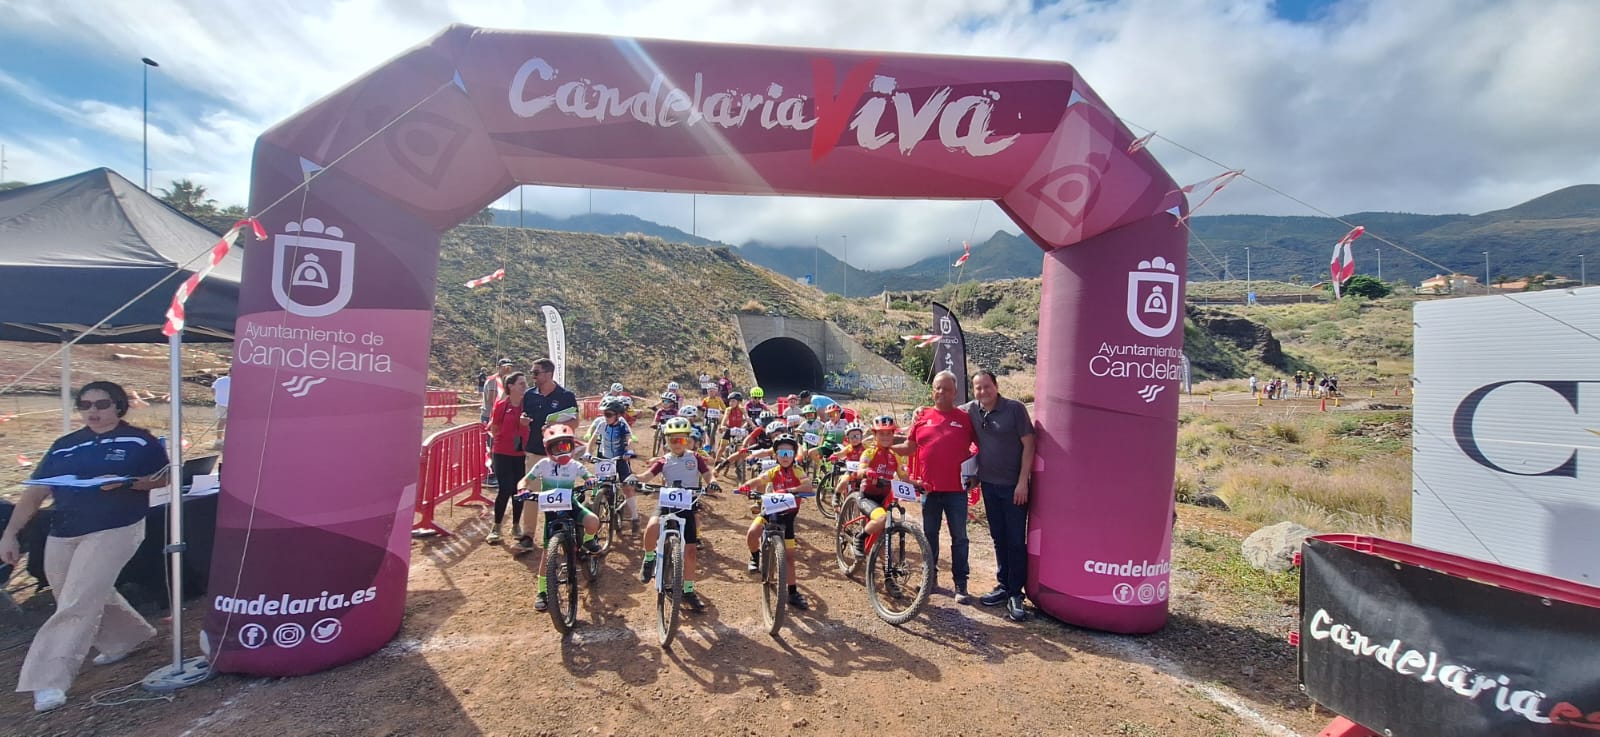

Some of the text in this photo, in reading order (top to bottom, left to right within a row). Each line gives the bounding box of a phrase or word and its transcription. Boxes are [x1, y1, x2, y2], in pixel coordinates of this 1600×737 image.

[508, 56, 1021, 164] Candelaria Viva
[245, 321, 384, 346] Ayuntamiento de
[238, 338, 392, 373] Candelaria
[1098, 342, 1177, 358] Ayuntamiento
[600, 463, 611, 472] 67
[546, 492, 563, 504] 64
[668, 491, 683, 502] 61
[898, 484, 911, 496] 63
[770, 494, 787, 504] 62
[214, 583, 377, 616] candelaria.es
[1310, 607, 1552, 724] Candelaria
